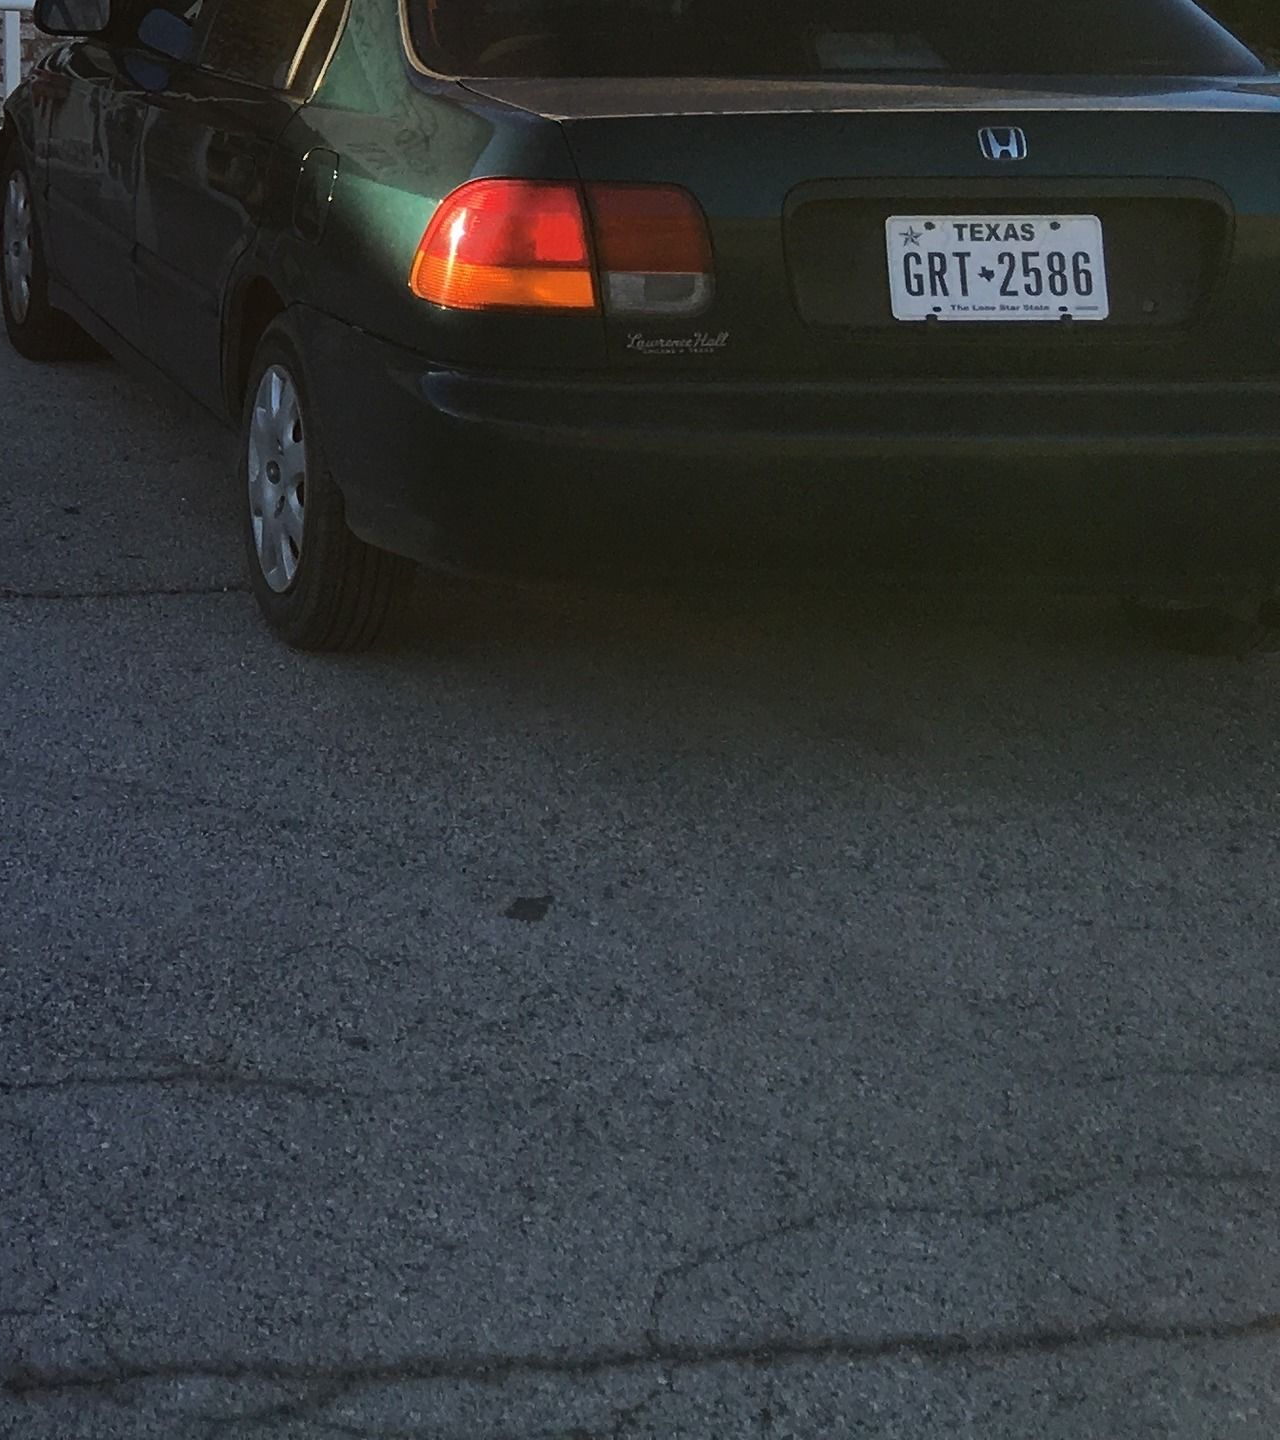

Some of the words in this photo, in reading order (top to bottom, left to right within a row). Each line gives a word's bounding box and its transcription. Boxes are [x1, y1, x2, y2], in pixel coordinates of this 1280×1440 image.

[953, 223, 1036, 242] TEXAS
[903, 251, 971, 297] GRT
[997, 251, 1093, 296] 2586
